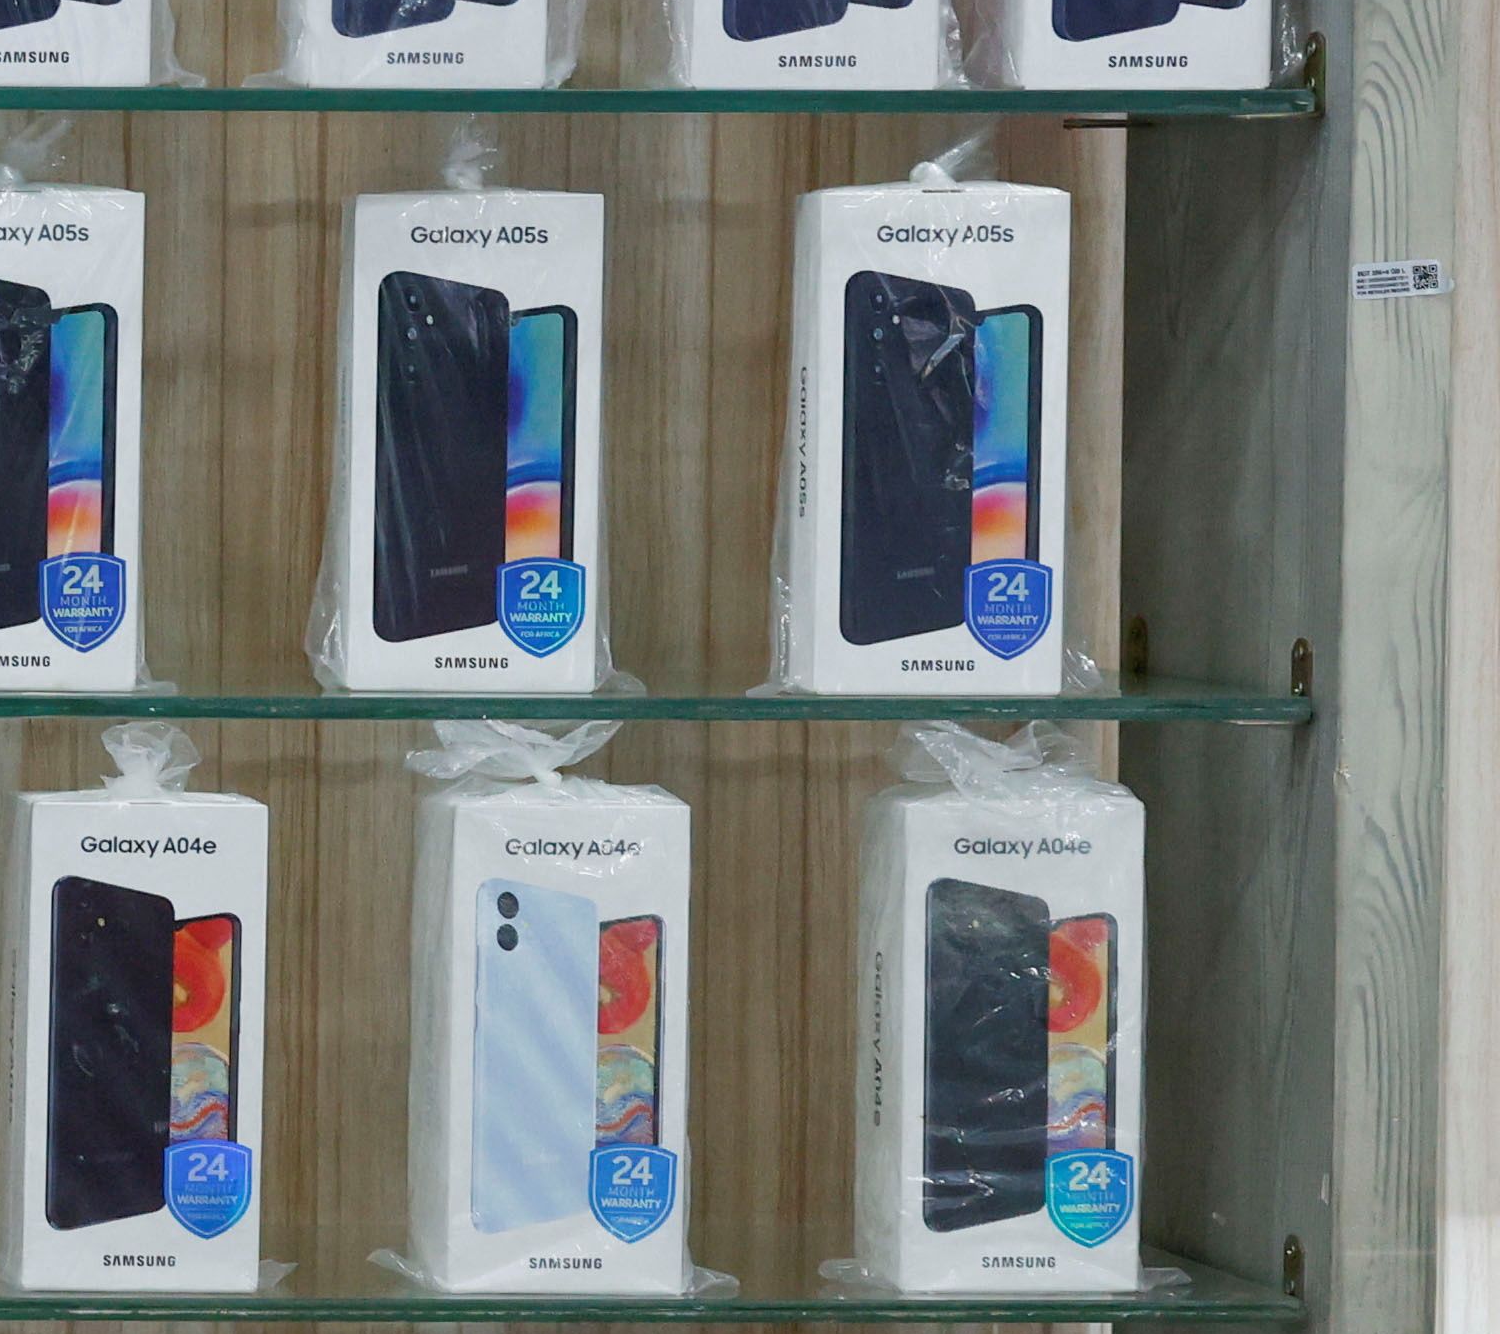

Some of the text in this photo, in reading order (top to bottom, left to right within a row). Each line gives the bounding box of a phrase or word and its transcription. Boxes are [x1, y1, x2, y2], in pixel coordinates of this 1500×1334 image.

[410, 225, 548, 249] Galaxy A05s
[434, 657, 508, 669] SAMSUNG
[954, 837, 1092, 859] Galaxy A04e
